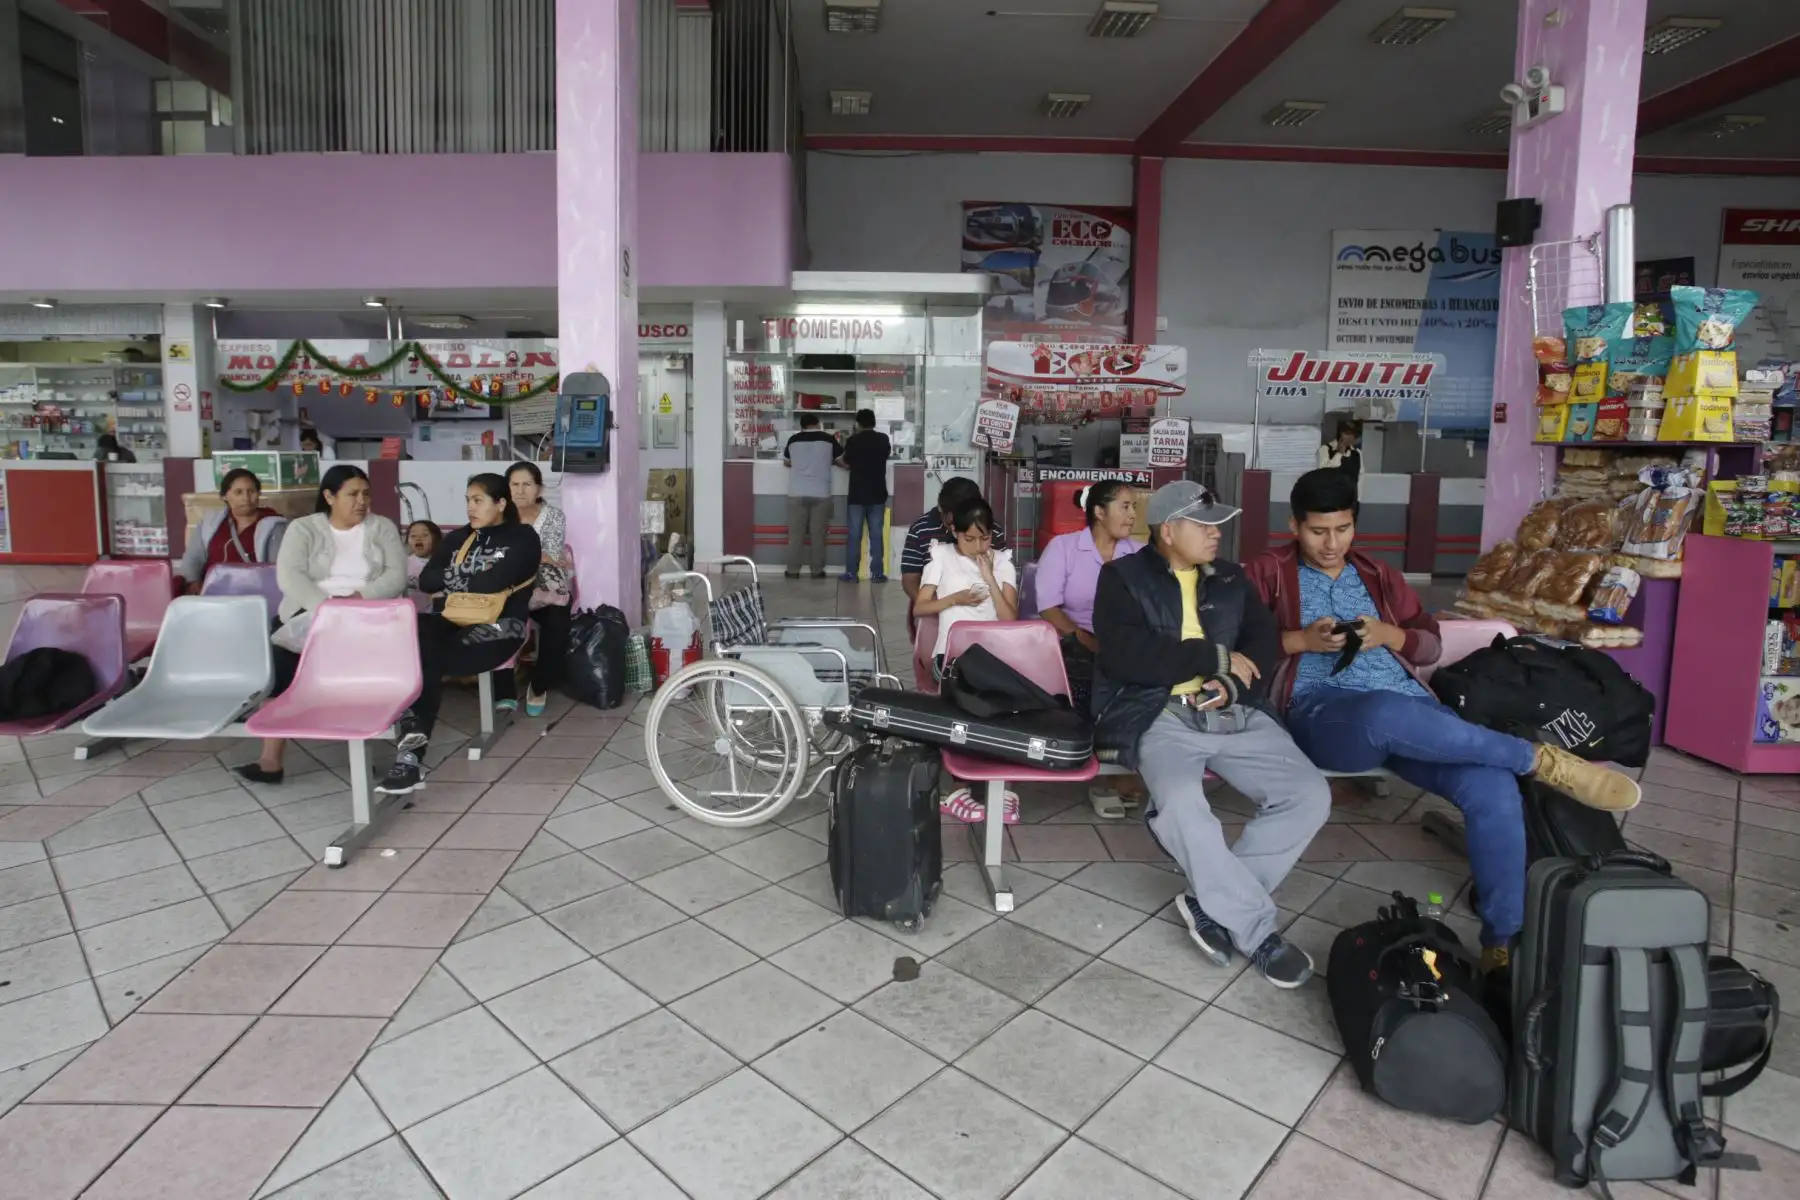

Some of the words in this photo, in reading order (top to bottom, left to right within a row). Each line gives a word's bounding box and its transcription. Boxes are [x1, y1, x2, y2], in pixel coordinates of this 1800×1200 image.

[1052, 220, 1112, 240] ECO
[1450, 237, 1502, 264] bus
[1337, 298, 1364, 309] ENVIO
[1366, 298, 1378, 309] DE
[1380, 298, 1438, 311] ENCOMIENDAS
[1337, 317, 1398, 327] DESCUENTO
[764, 317, 883, 340] ENCOMIENDAS
[1336, 334, 1367, 344] OCTUBRE
[1375, 334, 1415, 345] NOVIEMBRE
[218, 343, 272, 353] EXPRESO
[418, 343, 466, 352] XPRESO
[1266, 350, 1437, 387] JUDITH
[1265, 386, 1310, 397] LIMA
[976, 434, 1008, 447] HUACAYO
[1153, 438, 1185, 447] TARMA
[1039, 470, 1133, 482] ENCOMIENDAS
[1136, 472, 1150, 482] A:
[1541, 708, 1596, 749] IKE
